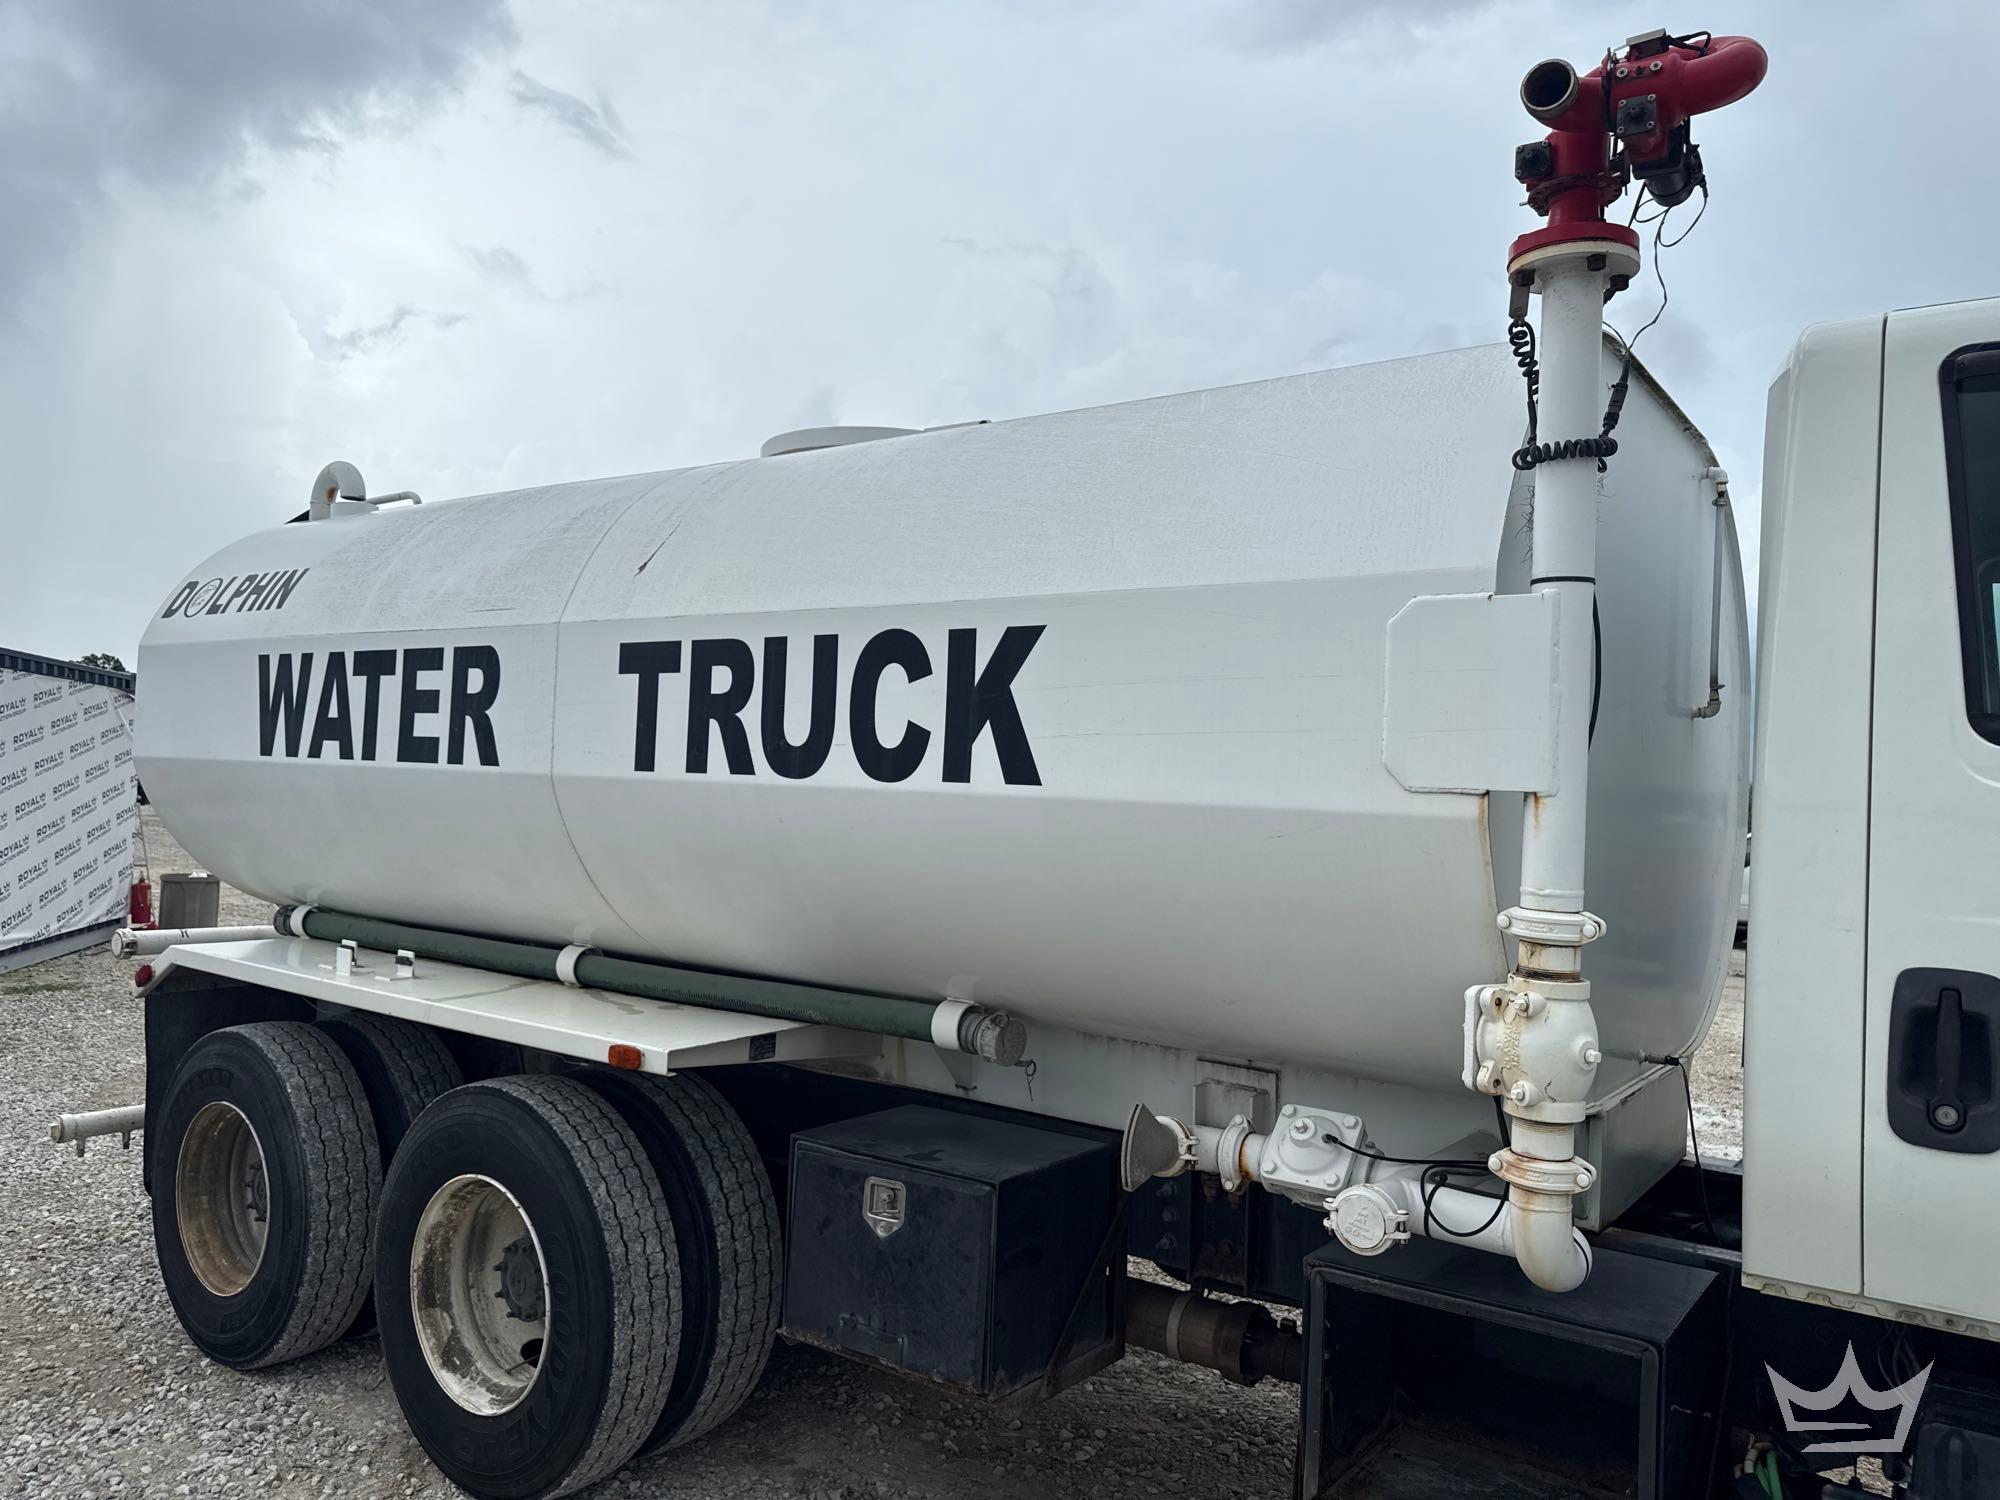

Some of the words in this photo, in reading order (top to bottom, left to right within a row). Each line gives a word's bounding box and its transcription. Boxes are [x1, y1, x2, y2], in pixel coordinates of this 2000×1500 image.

[161, 567, 310, 619] DOLPHIN
[0, 699, 20, 714] OYAL
[258, 645, 500, 767] WATER
[618, 625, 1047, 786] TRUCK
